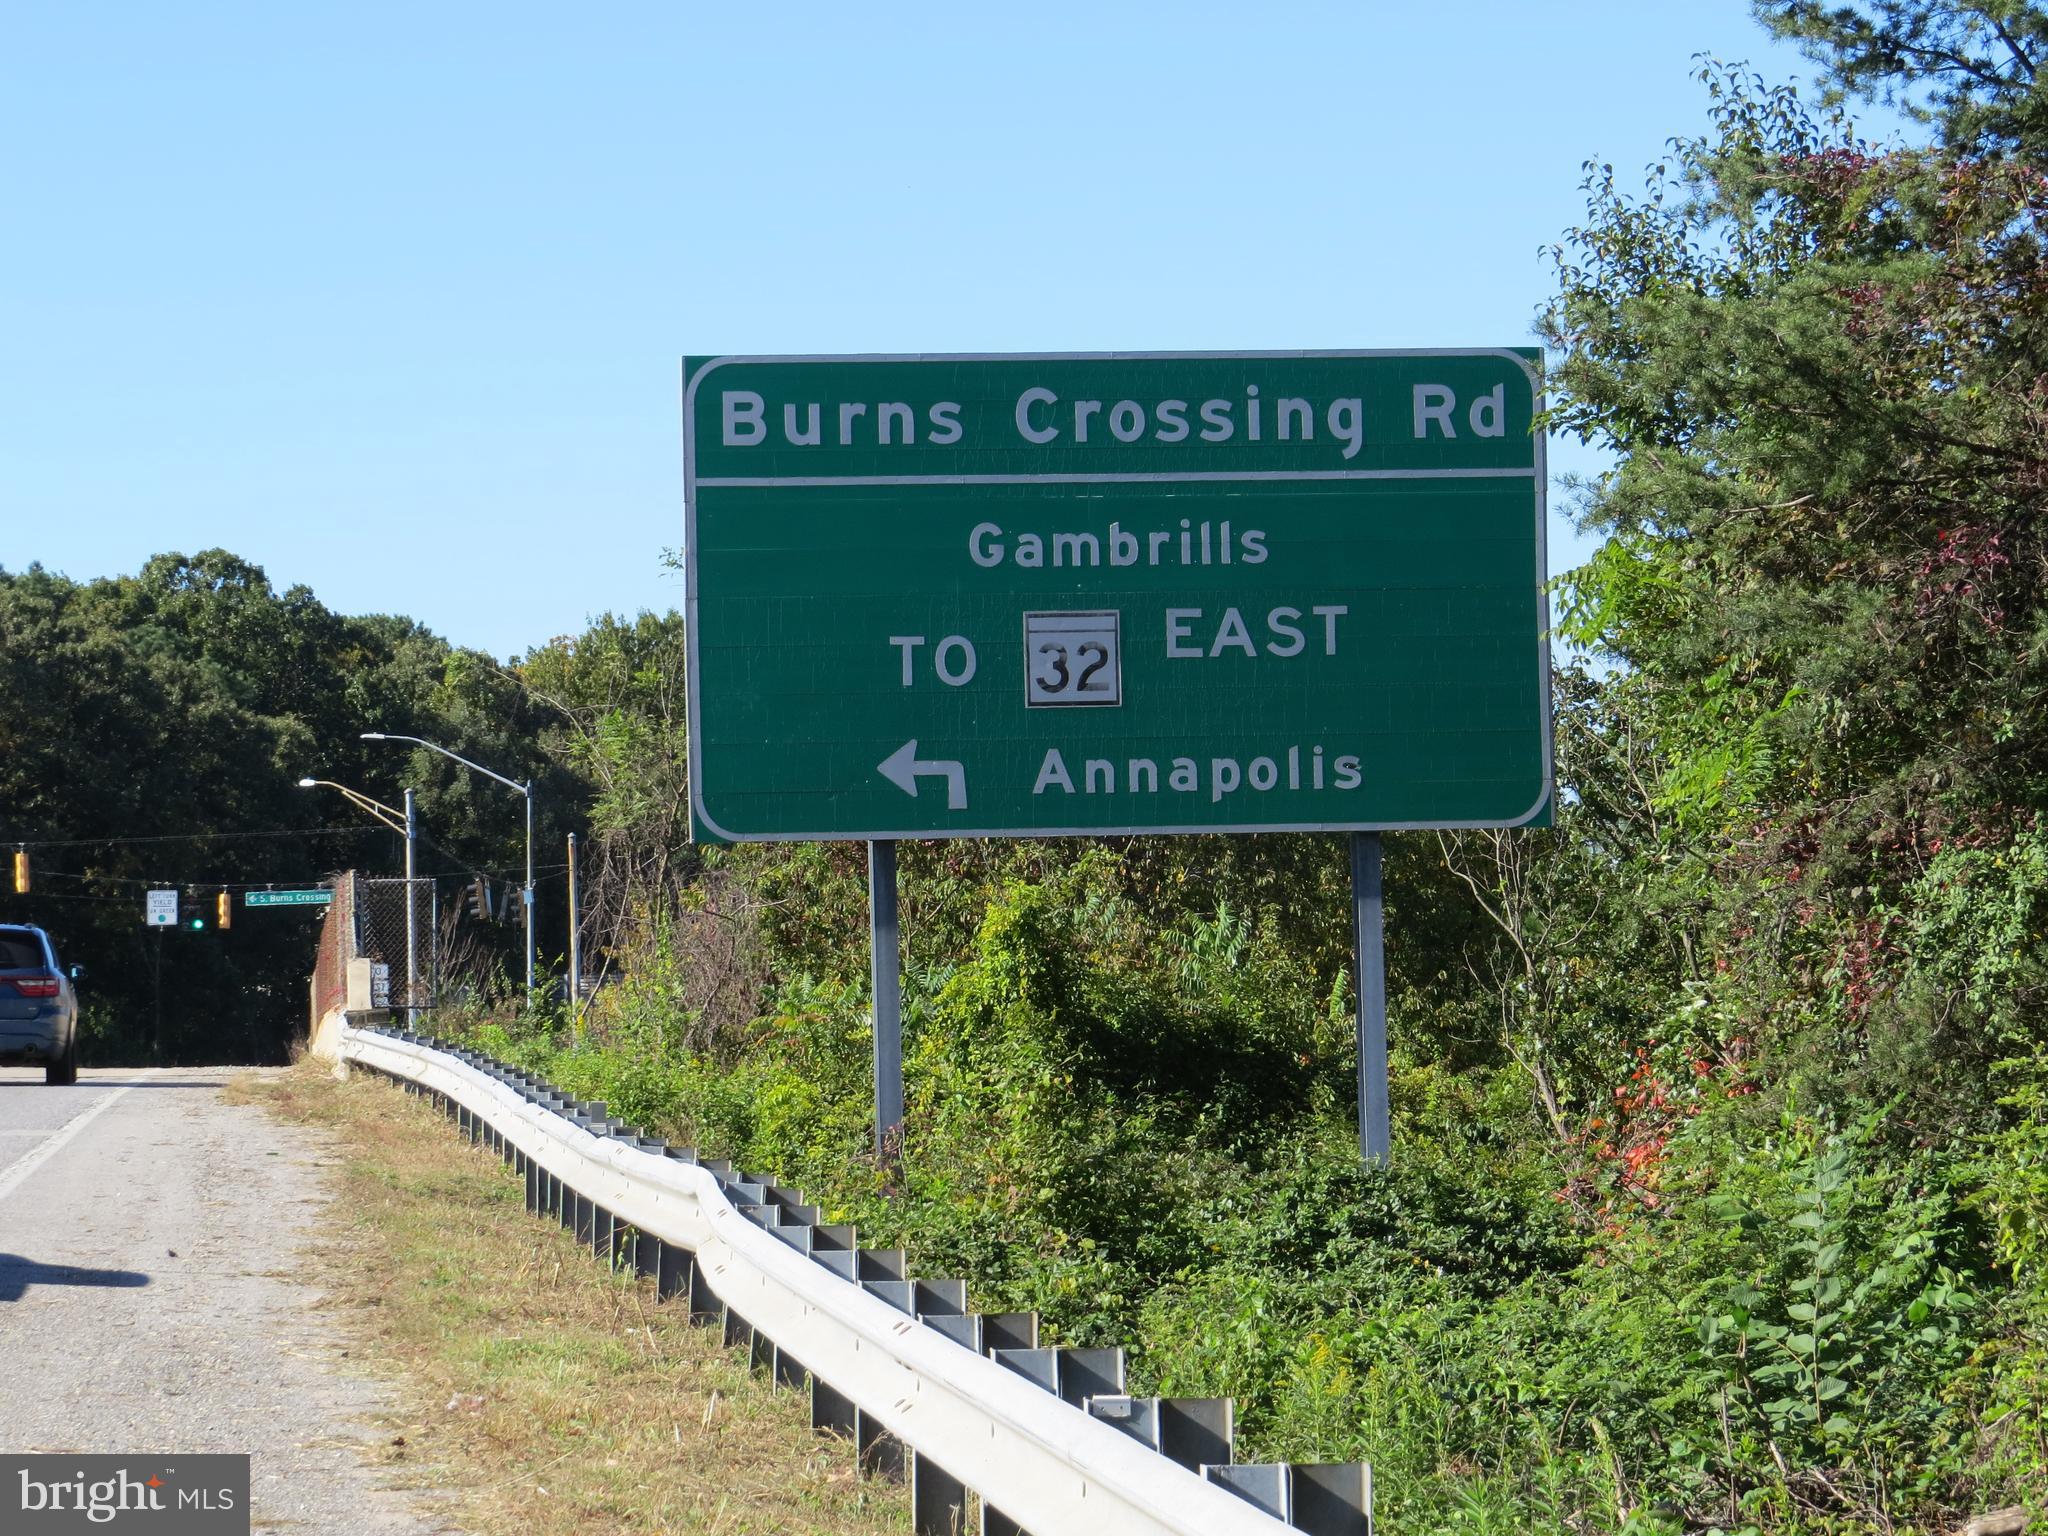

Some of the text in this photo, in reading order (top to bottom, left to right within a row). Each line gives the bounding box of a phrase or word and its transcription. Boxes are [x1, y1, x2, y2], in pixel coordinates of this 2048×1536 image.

[722, 383, 1505, 460] Burns Crossing Rd
[969, 518, 1268, 567] Gambrills
[889, 605, 1348, 693] TO 32 EAST
[1032, 745, 1362, 803] Annapolis
[269, 895, 293, 903] Burns
[296, 893, 331, 903] Crossing
